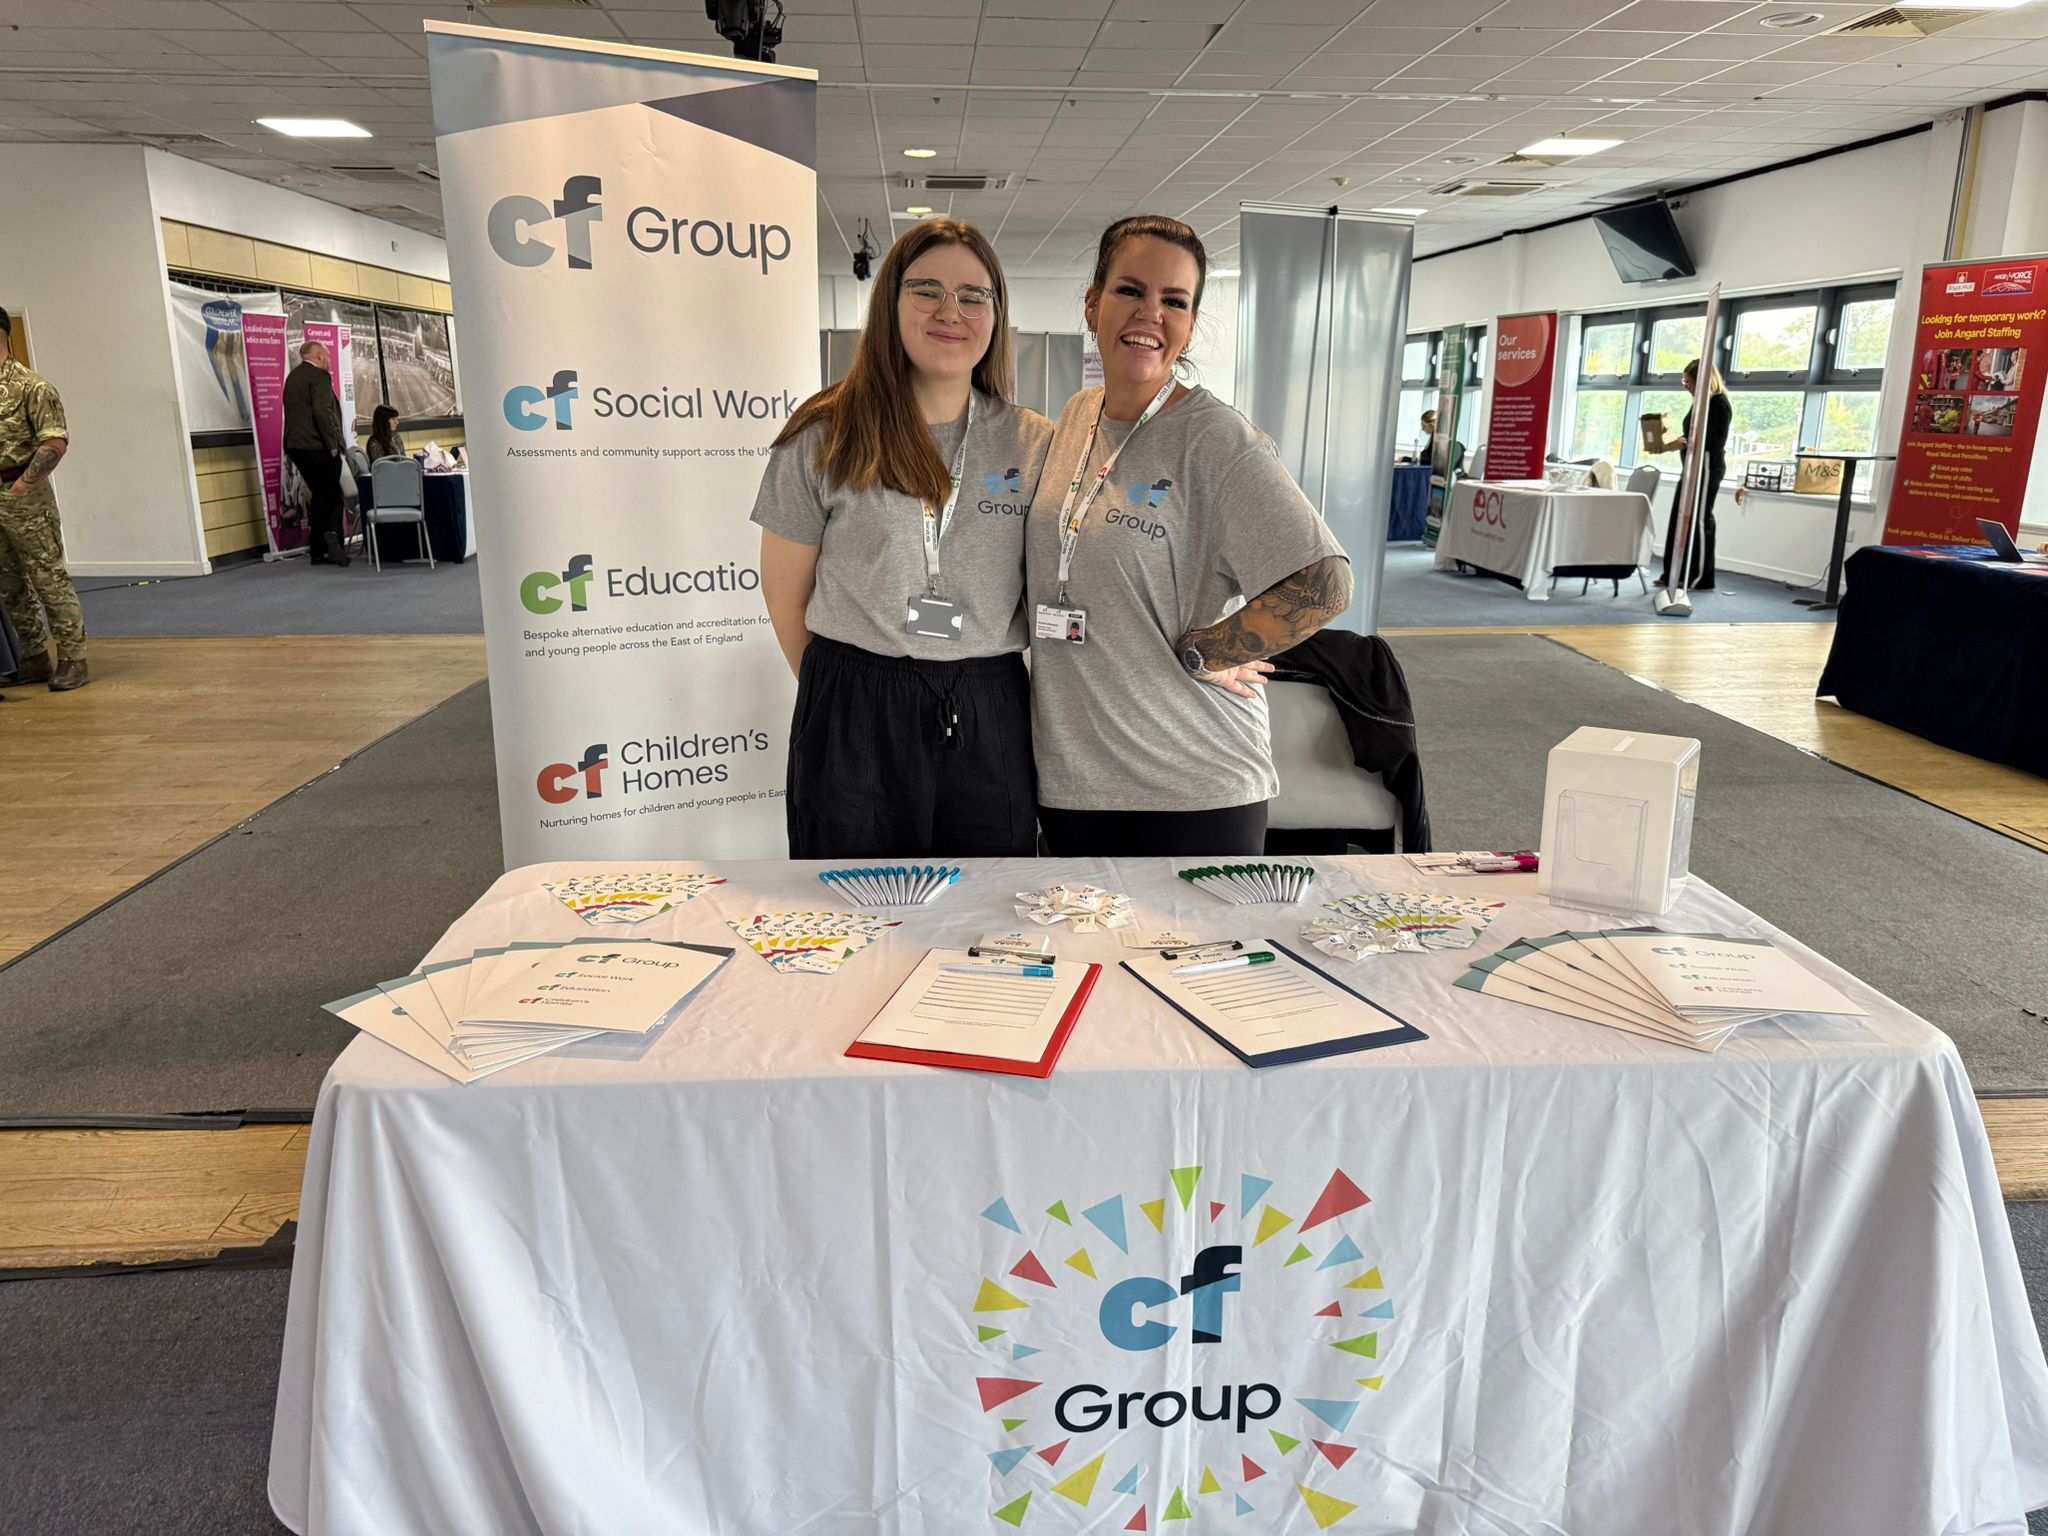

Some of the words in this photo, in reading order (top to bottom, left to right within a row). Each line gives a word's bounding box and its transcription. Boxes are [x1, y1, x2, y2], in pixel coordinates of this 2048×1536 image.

[487, 175, 603, 270] cf
[626, 206, 791, 275] Group
[1921, 314, 1952, 325] Looking
[1953, 313, 1968, 323] for
[1969, 312, 2015, 323] temporary
[2016, 309, 2047, 320] work?
[1499, 334, 1518, 346] Our
[1934, 330, 1953, 339] Join
[1954, 328, 1986, 340] Angard
[1987, 327, 2022, 339] Staffing
[1497, 347, 1537, 360] services
[503, 370, 578, 431] cf
[592, 386, 702, 419] Social
[712, 389, 799, 420] Work
[507, 447, 577, 457] Assessments
[581, 447, 599, 457] and
[602, 446, 660, 459] community
[662, 447, 701, 460] support
[704, 449, 734, 457] across
[738, 447, 754, 457] the
[757, 447, 771, 457] UK
[984, 468, 1020, 495] cf
[1805, 462, 1841, 478] M&S
[1126, 479, 1173, 508] cf
[1105, 508, 1166, 541] Group
[519, 554, 594, 615] cf
[607, 561, 759, 597] Educatio
[523, 629, 569, 642] Bespoke
[571, 625, 623, 638] alternative
[626, 621, 673, 633] education
[676, 619, 694, 630] and
[696, 616, 756, 628] accreditation
[758, 616, 771, 625] for
[525, 648, 545, 658] and
[548, 646, 580, 659] young
[583, 642, 617, 656] people
[619, 640, 650, 650] across
[652, 638, 668, 648] the
[670, 636, 691, 647] East
[694, 634, 703, 645] of
[705, 633, 744, 647] England
[537, 743, 609, 804] cf
[621, 729, 769, 765] Children's
[623, 763, 729, 794] Homes
[540, 814, 588, 829] Nurturing
[590, 810, 622, 822] homes
[623, 806, 637, 817] for
[639, 801, 675, 815] children
[677, 798, 695, 810] and
[696, 796, 724, 809] young
[726, 792, 757, 805] people
[758, 790, 767, 799] in
[768, 789, 787, 798] East
[577, 953, 621, 964] cf
[622, 957, 679, 969] Group
[1651, 947, 1688, 957] cf
[1695, 950, 1756, 960] Group
[1099, 1245, 1243, 1352] cf
[1054, 1382, 1282, 1434] Group
